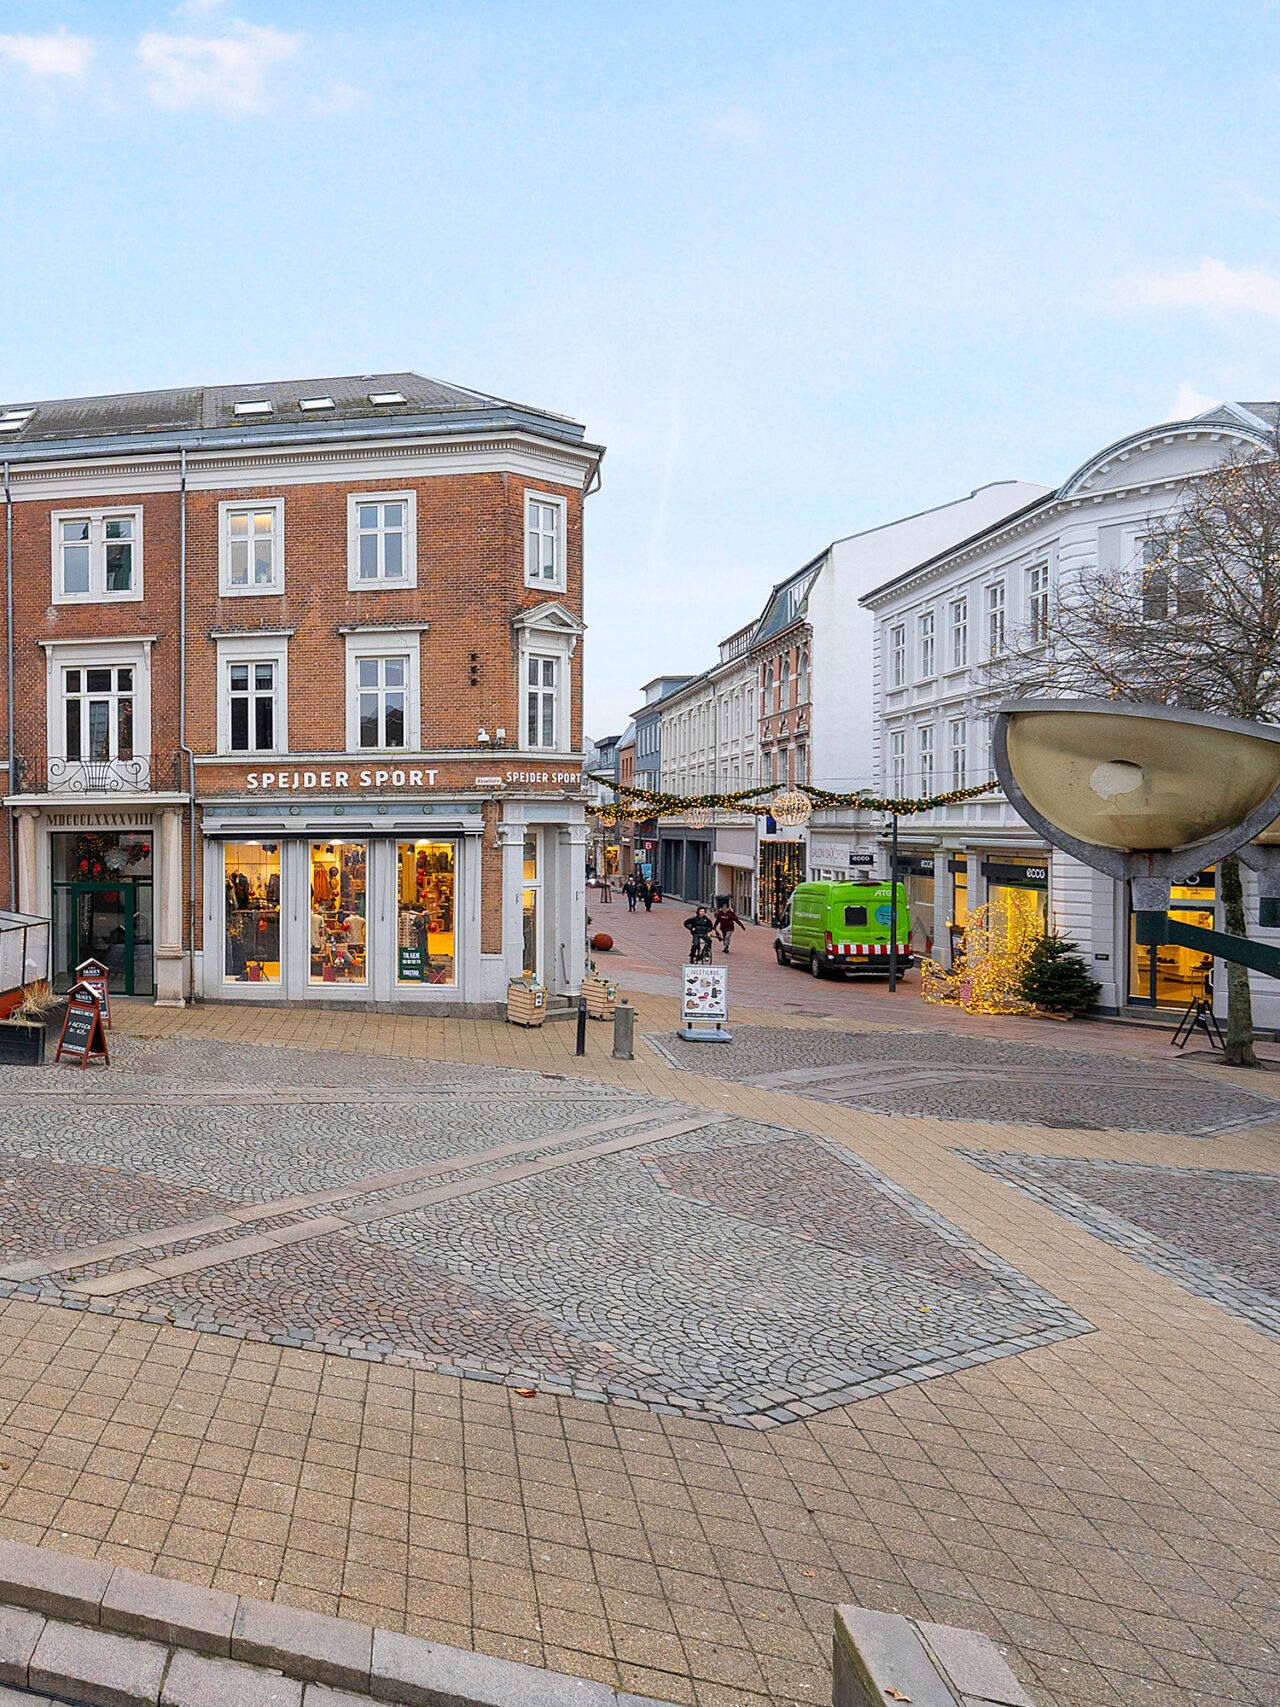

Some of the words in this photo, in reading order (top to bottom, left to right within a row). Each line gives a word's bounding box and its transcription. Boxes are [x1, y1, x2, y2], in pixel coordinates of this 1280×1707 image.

[246, 771, 349, 789] SPEJDER
[359, 769, 439, 787] SPORT
[506, 771, 549, 783] SPEJDER
[551, 772, 581, 784] SPORT
[1026, 867, 1046, 879] ecco
